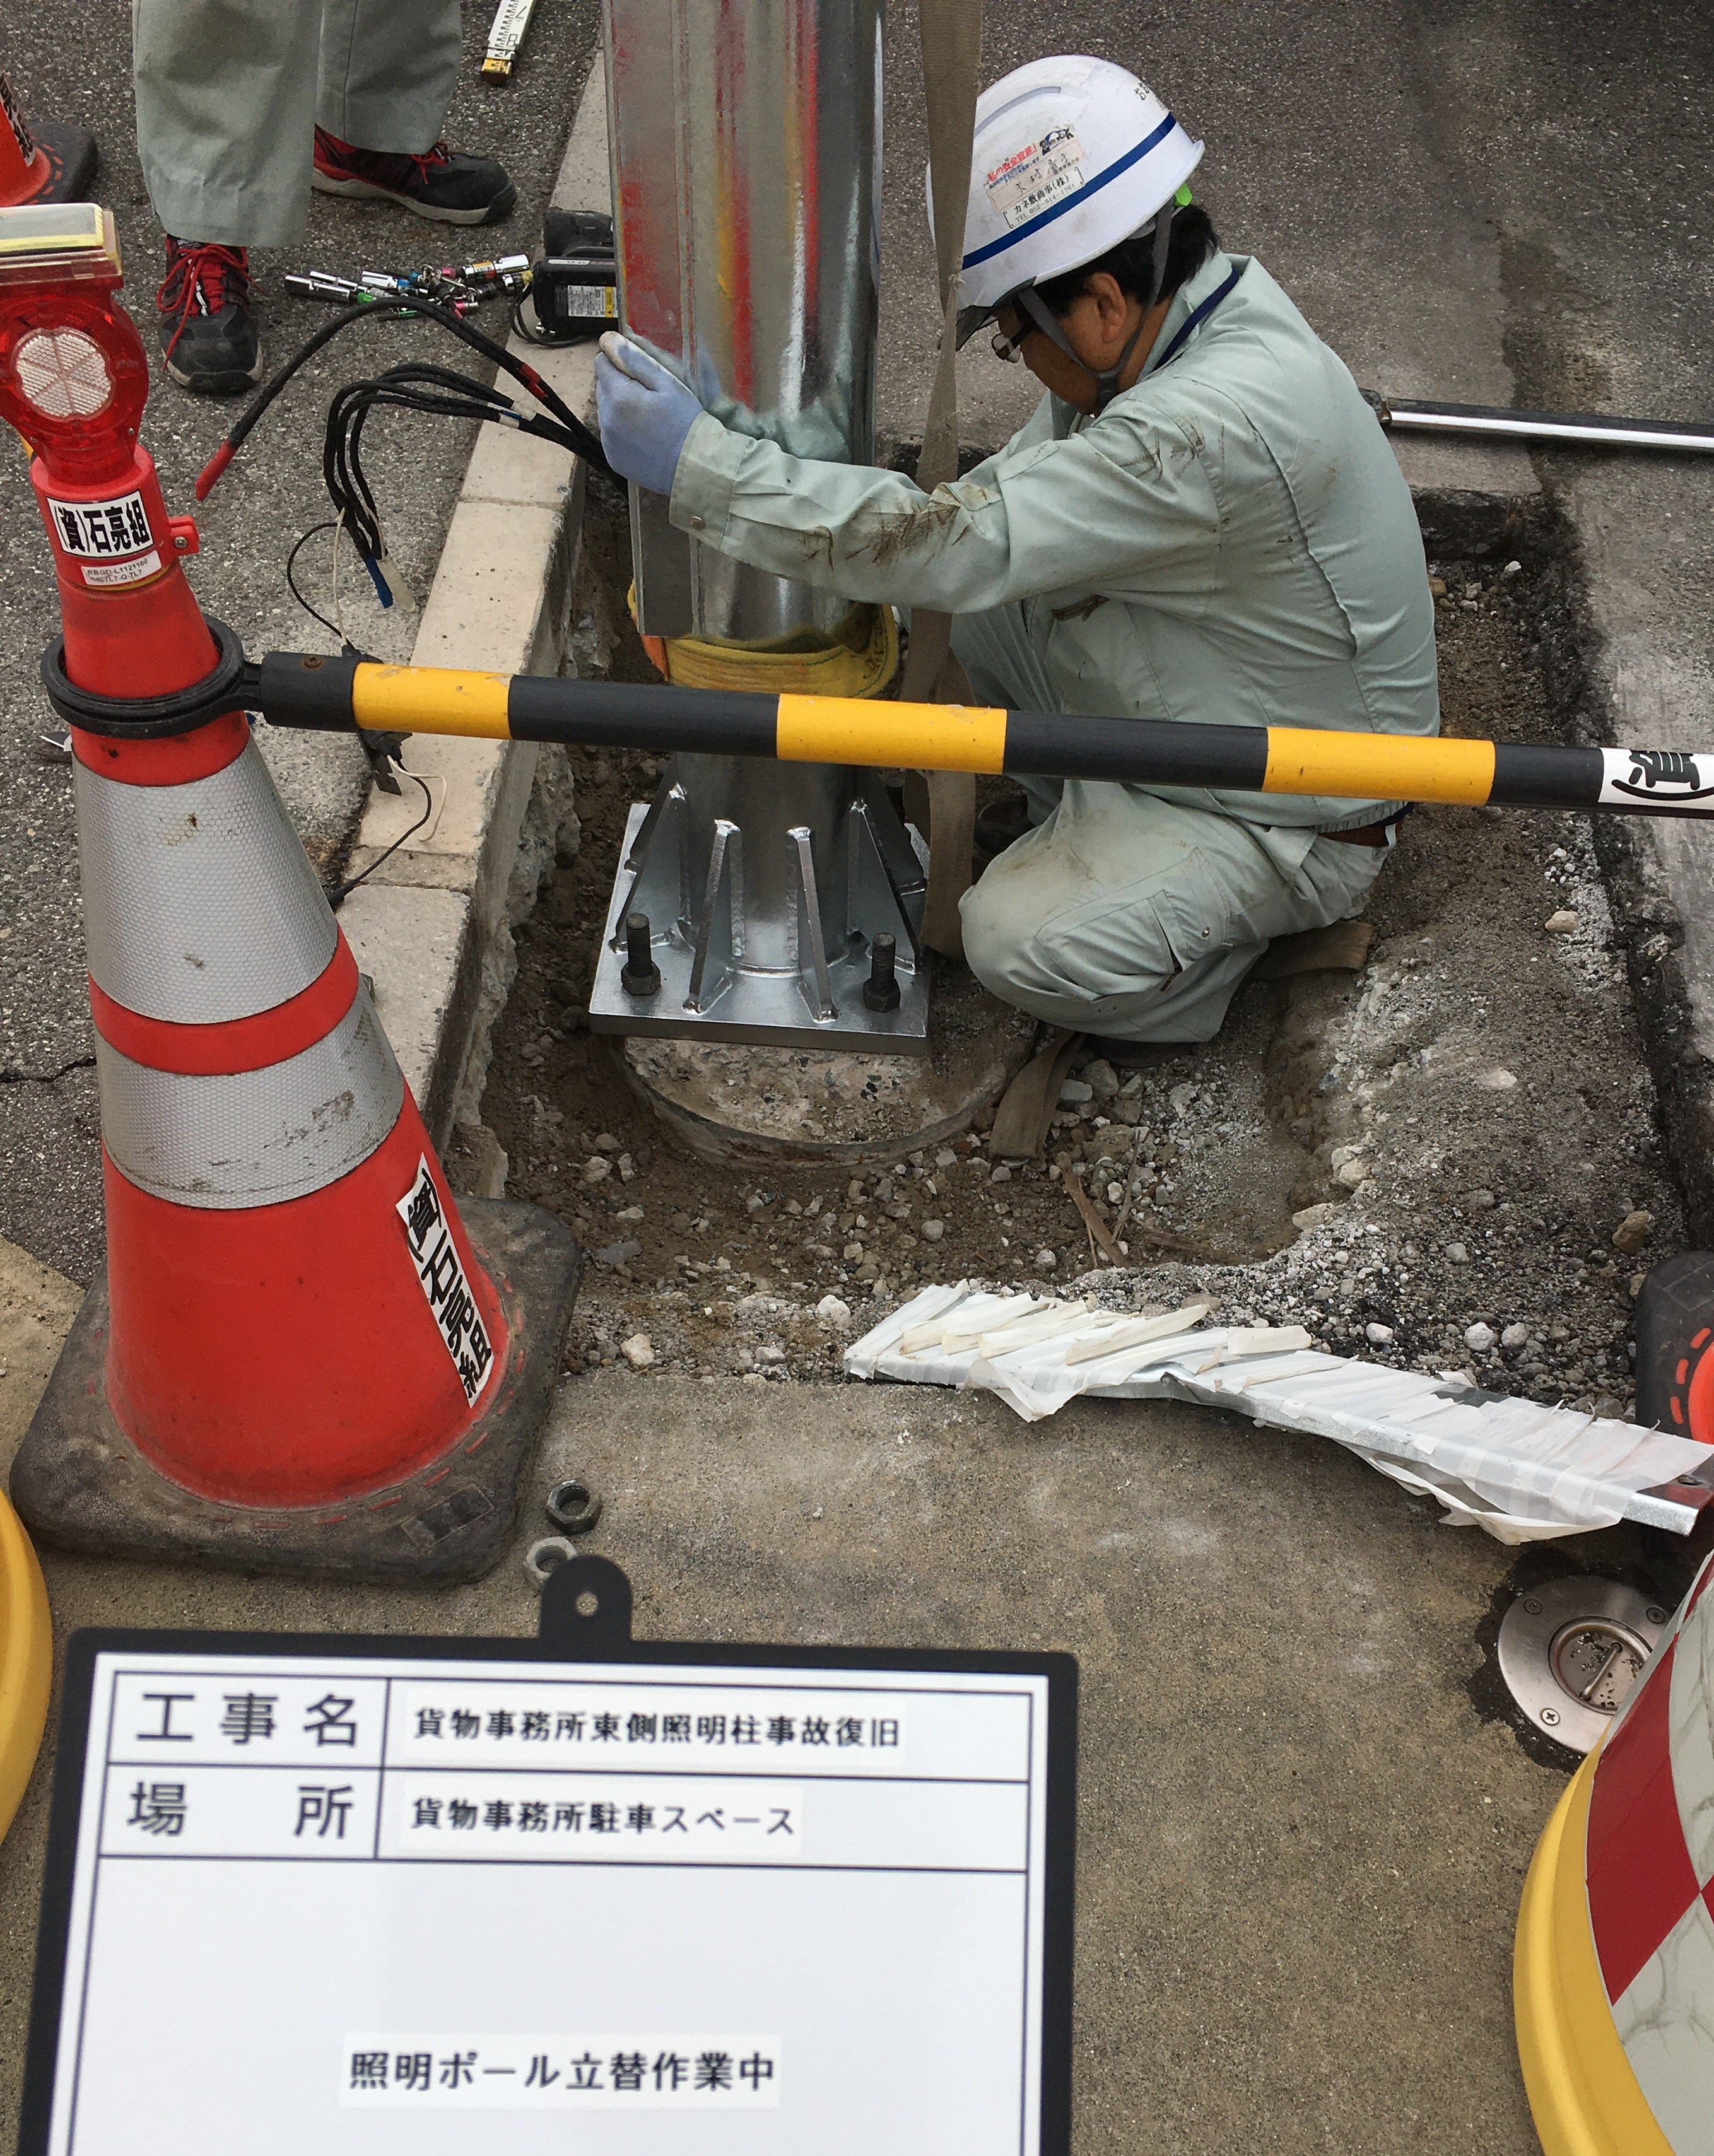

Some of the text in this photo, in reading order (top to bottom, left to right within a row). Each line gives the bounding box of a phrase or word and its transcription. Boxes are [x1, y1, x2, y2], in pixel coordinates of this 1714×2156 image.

[135, 1691, 358, 1747] 工事名
[413, 1707, 900, 1748] 貨物事務所東側照明柱事故復旧
[126, 1780, 354, 1839] 場所
[411, 1796, 795, 1836] 貨物事務所駐車スペース
[349, 2049, 775, 2092] 照明ポール立替作業中
